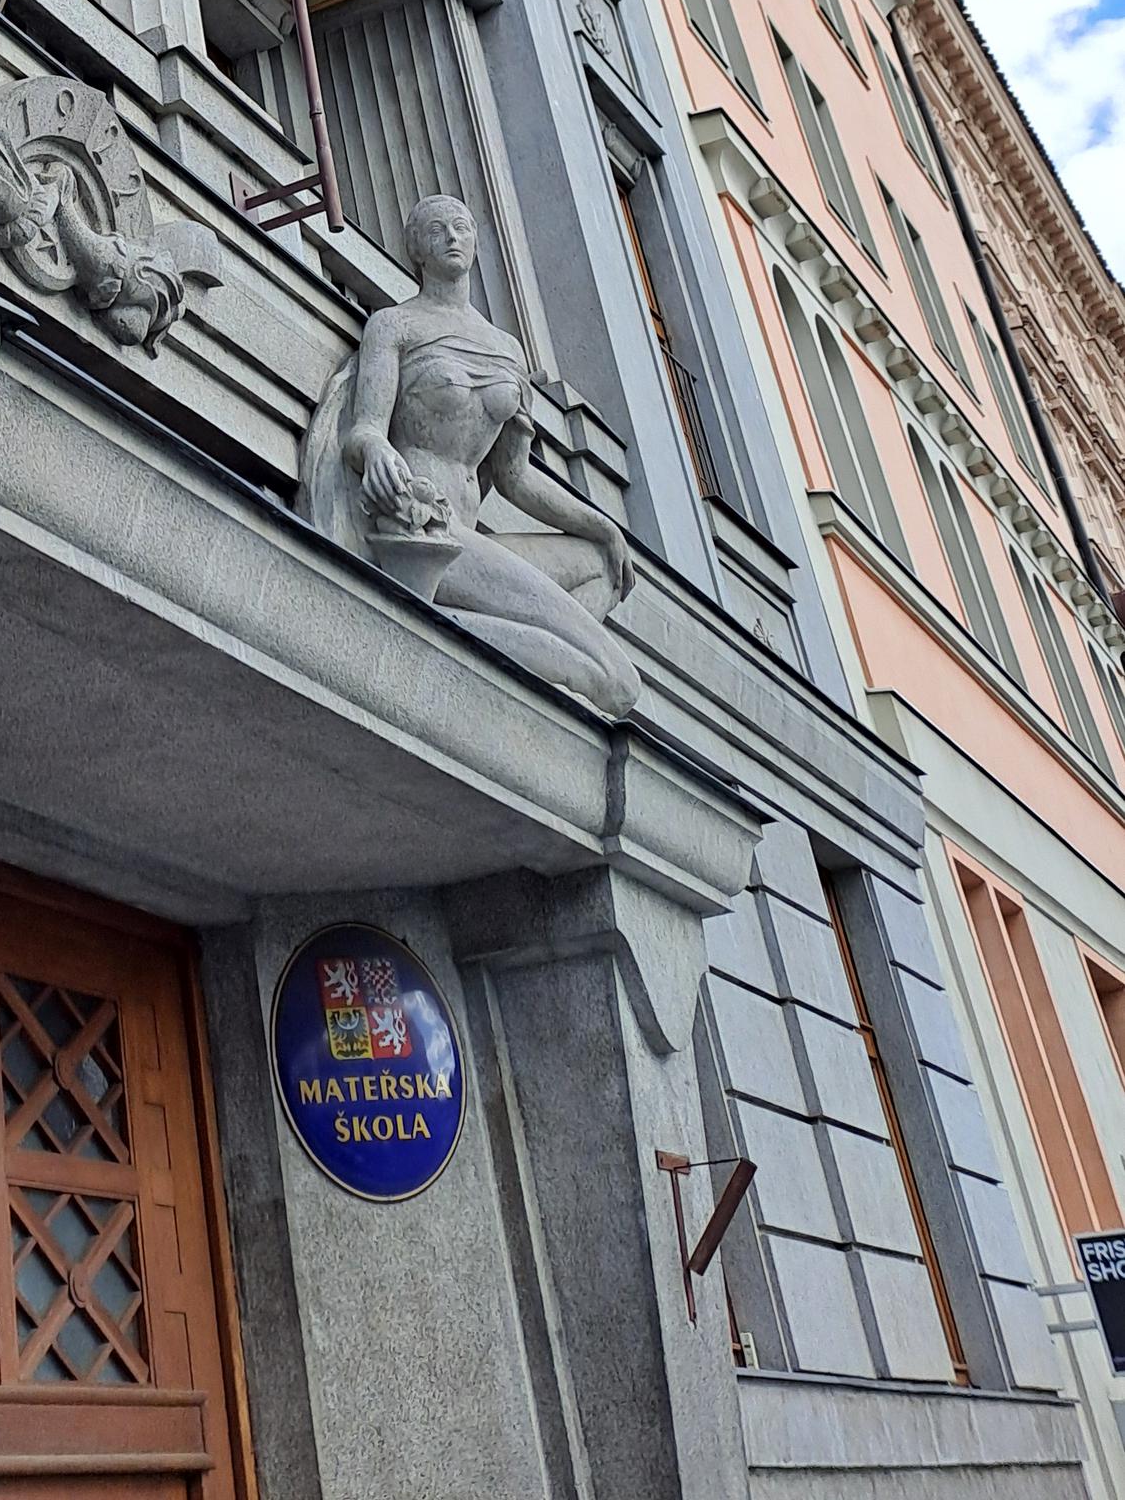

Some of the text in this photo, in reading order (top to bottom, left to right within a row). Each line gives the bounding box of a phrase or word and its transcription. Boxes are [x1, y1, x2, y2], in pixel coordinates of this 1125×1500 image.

[299, 1068, 453, 1105] MATEŘSKÁ
[334, 1110, 431, 1143] ŠKOLA
[1081, 1240, 1125, 1262] FRIS
